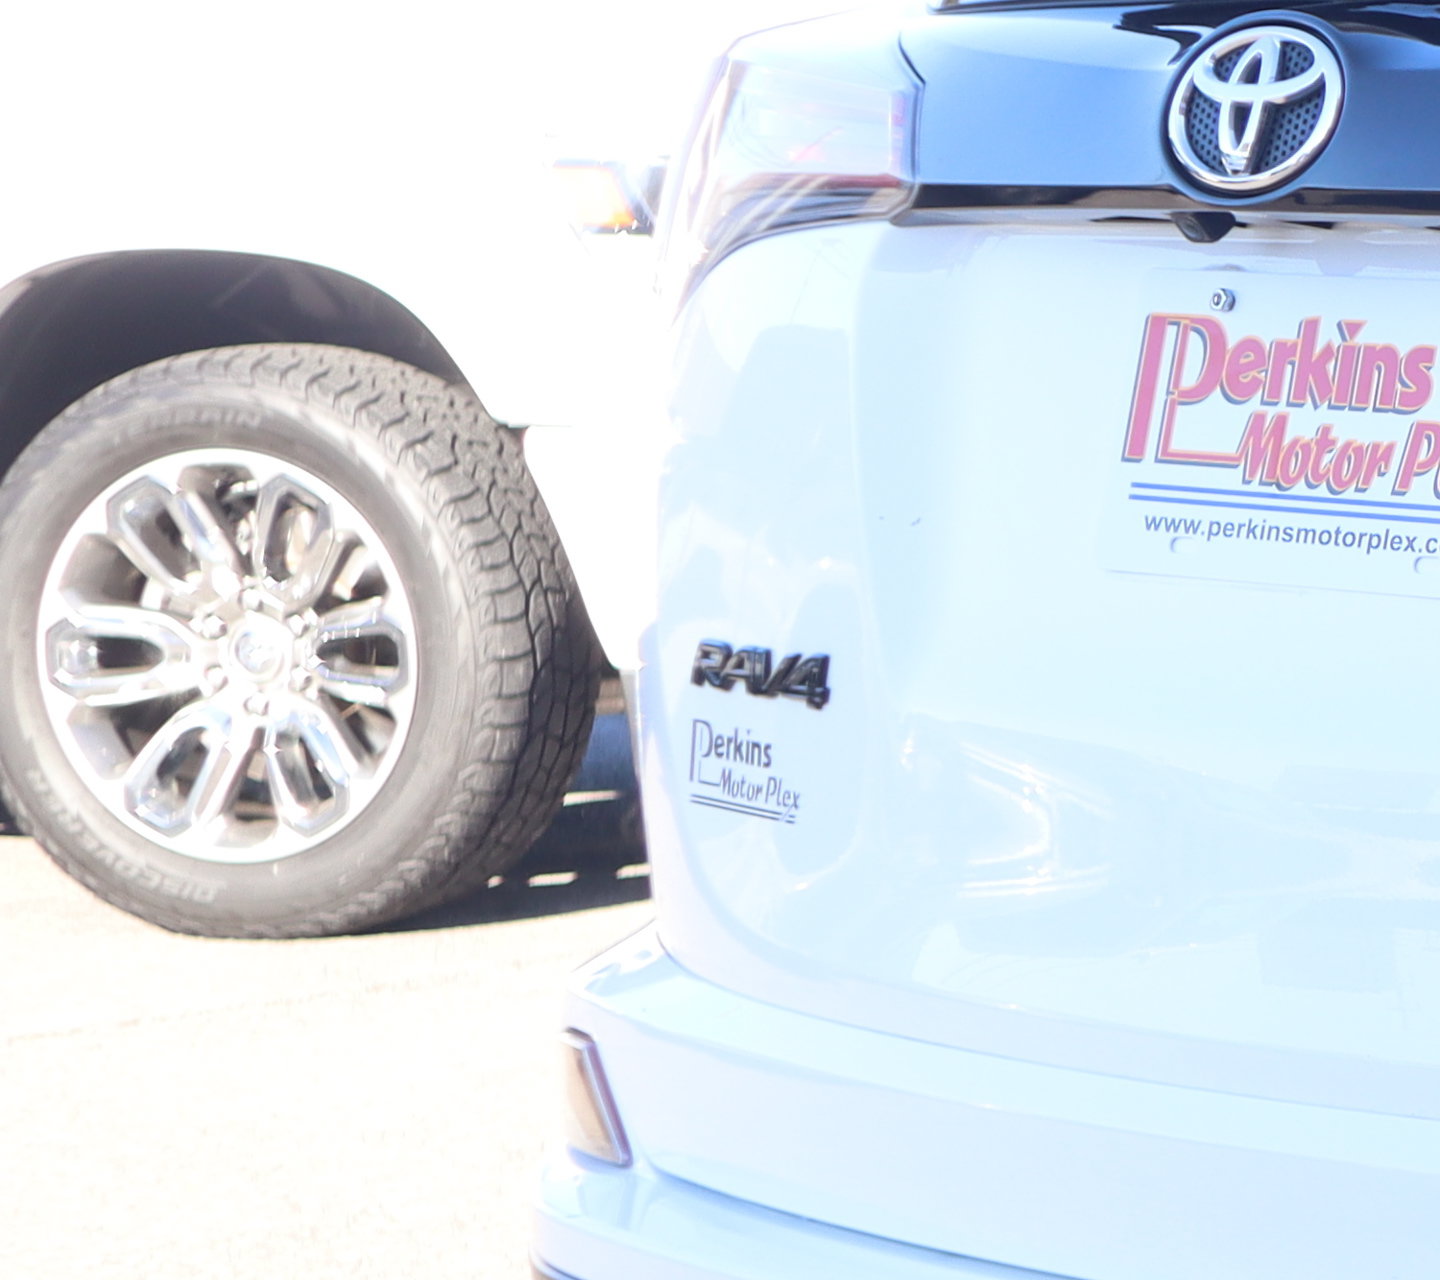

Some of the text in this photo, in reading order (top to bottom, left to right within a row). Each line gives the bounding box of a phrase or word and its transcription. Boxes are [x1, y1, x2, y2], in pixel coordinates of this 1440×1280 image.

[1121, 312, 1439, 462] Perkins
[1243, 411, 1397, 496] Motor
[690, 638, 831, 711] RAV4
[689, 718, 772, 782] Perkins
[719, 767, 801, 812] Motor Plex
